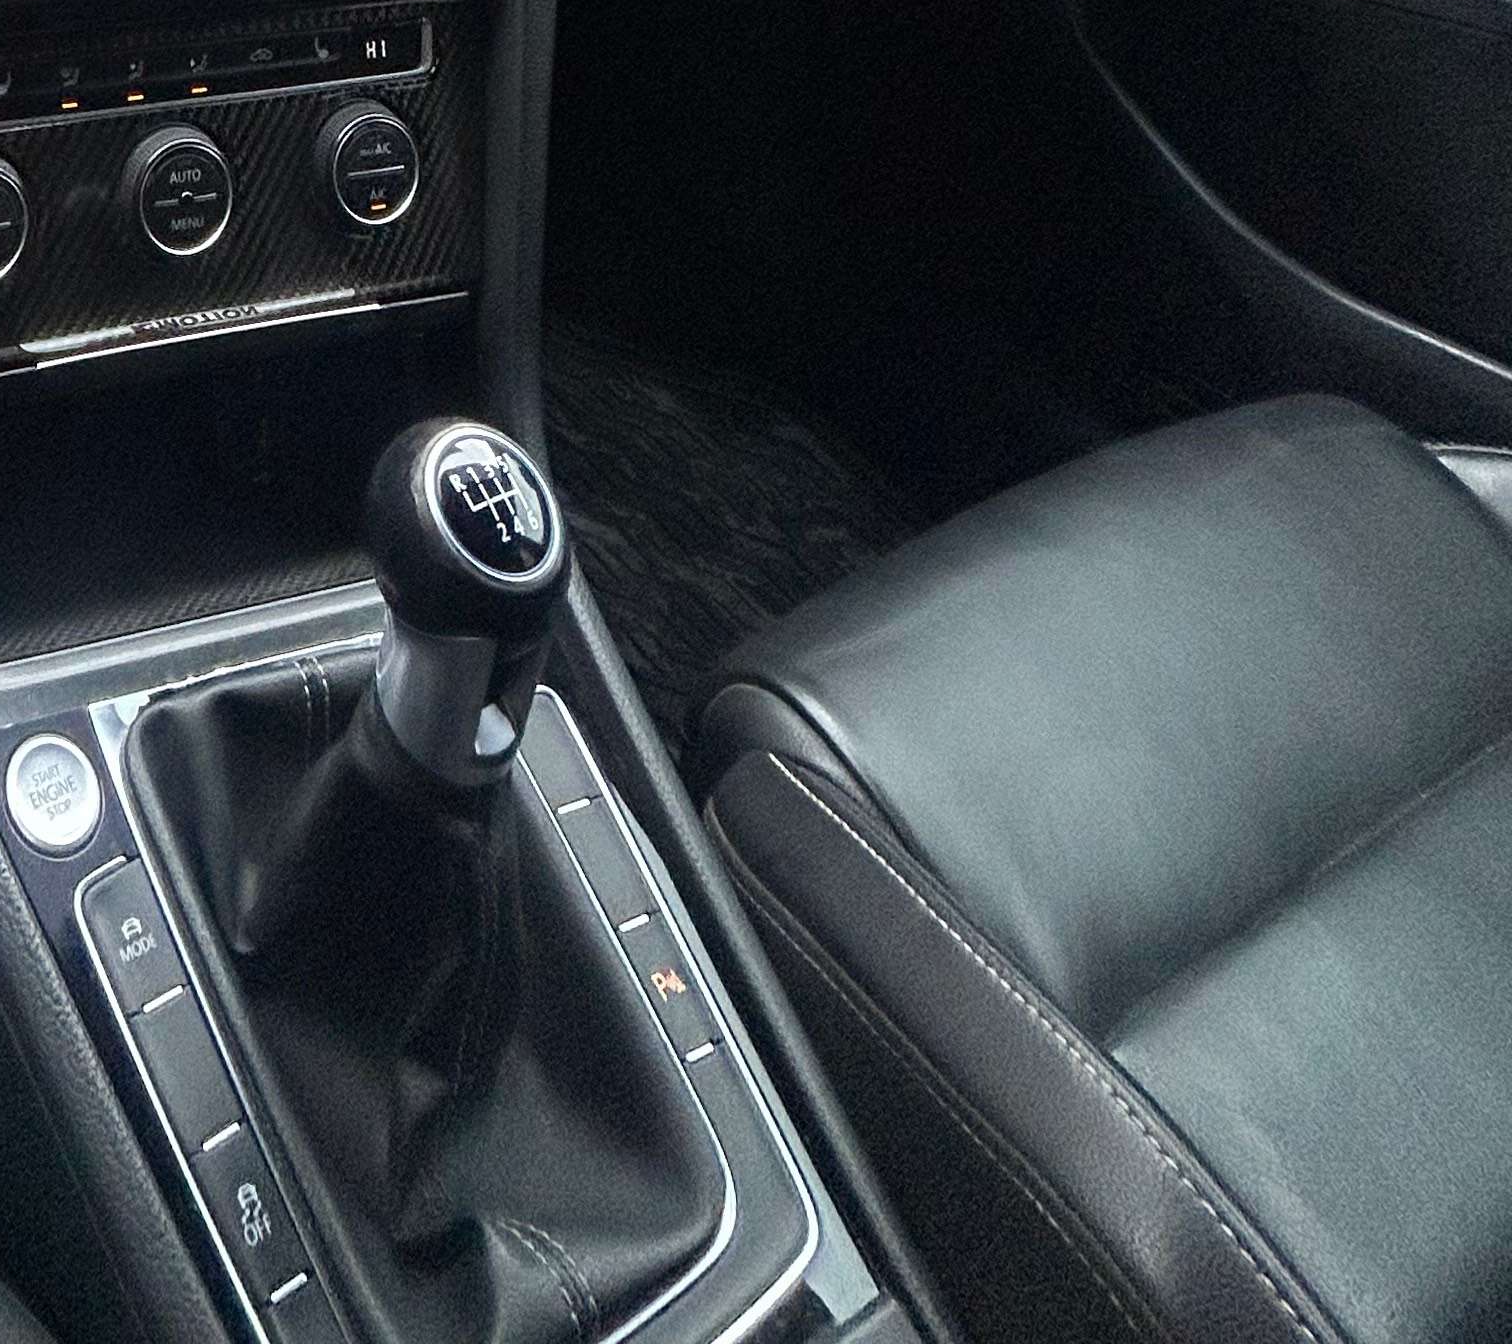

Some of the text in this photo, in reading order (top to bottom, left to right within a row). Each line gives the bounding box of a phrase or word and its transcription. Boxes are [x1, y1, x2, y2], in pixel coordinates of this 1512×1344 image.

[169, 168, 201, 184] AUTO
[169, 216, 205, 231] MENU
[449, 473, 467, 493] R
[496, 509, 539, 543] 2 4 6
[31, 763, 60, 788] START
[29, 775, 78, 810] ENGINE
[47, 798, 72, 821] STOP
[119, 933, 157, 964] MODE
[243, 1213, 272, 1247] OFF
